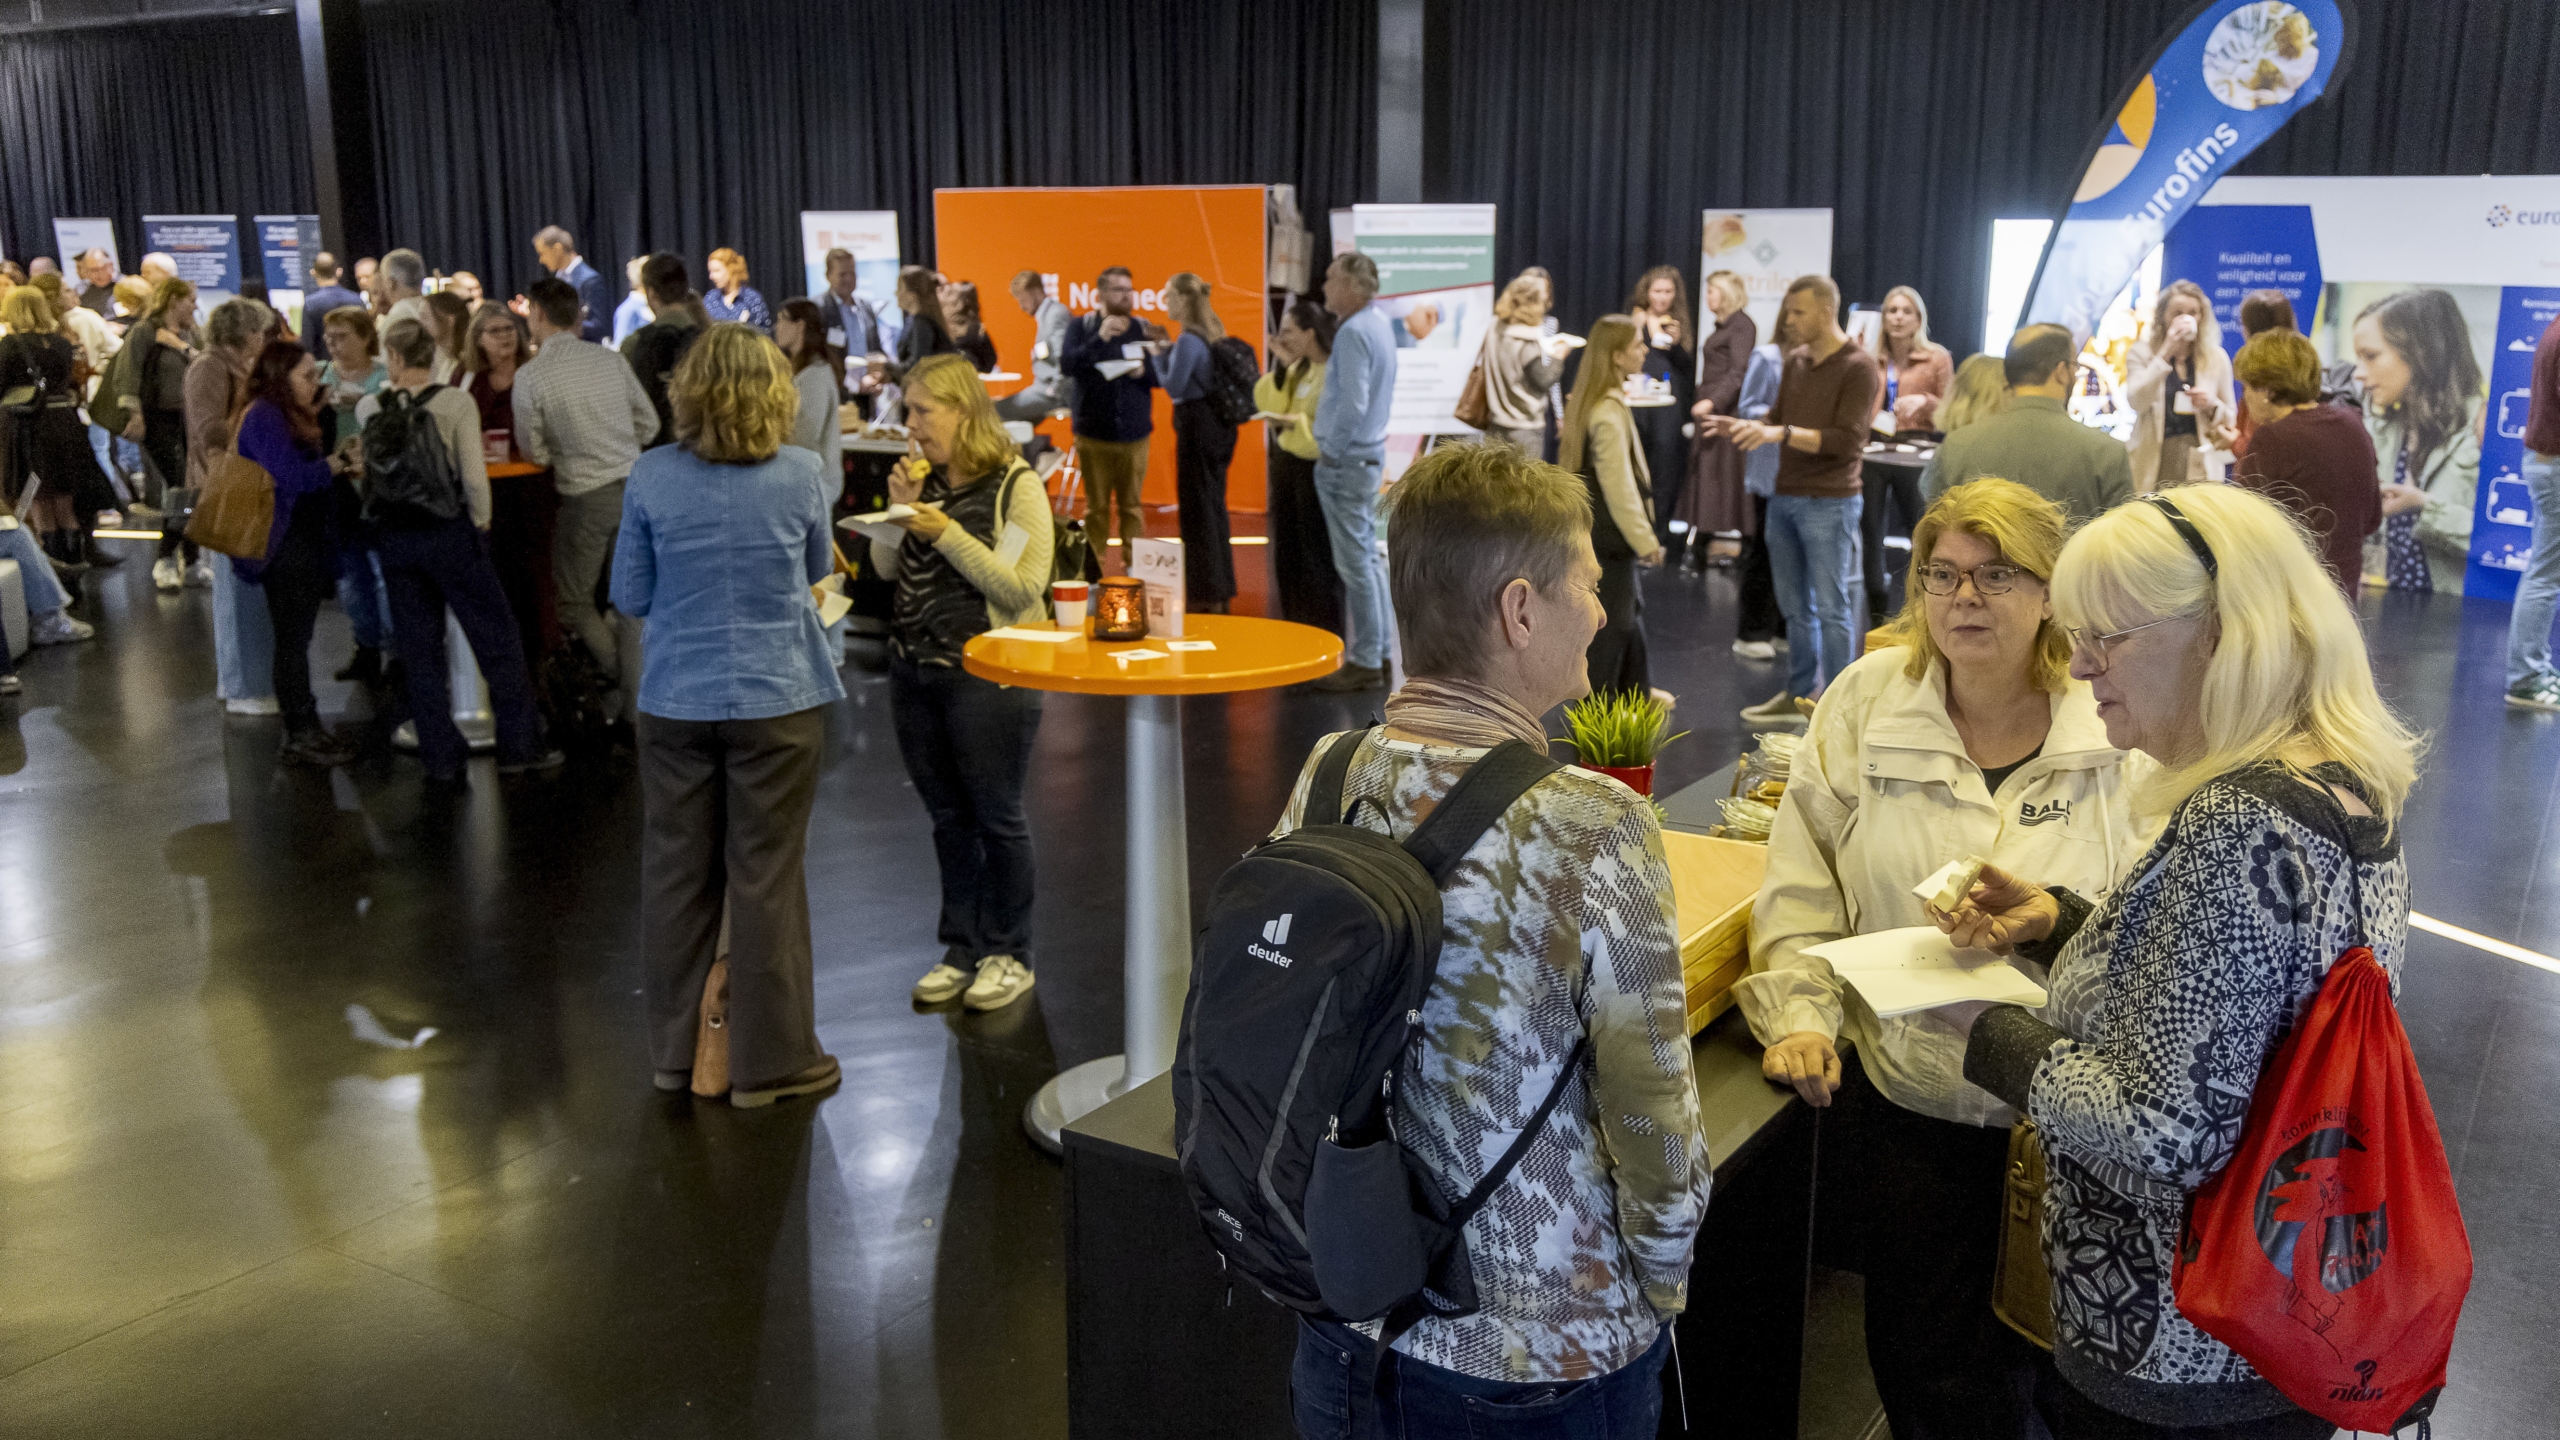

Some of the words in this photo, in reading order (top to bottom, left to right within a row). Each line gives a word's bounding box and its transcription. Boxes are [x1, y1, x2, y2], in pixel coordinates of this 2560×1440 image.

[2219, 252, 2272, 265] Kwaliteit
[2273, 253, 2292, 265] en
[2217, 269, 2277, 284] veiligheid
[2278, 271, 2306, 283] voor
[1247, 943, 1293, 969] deuter
[1218, 1208, 1242, 1230] Race
